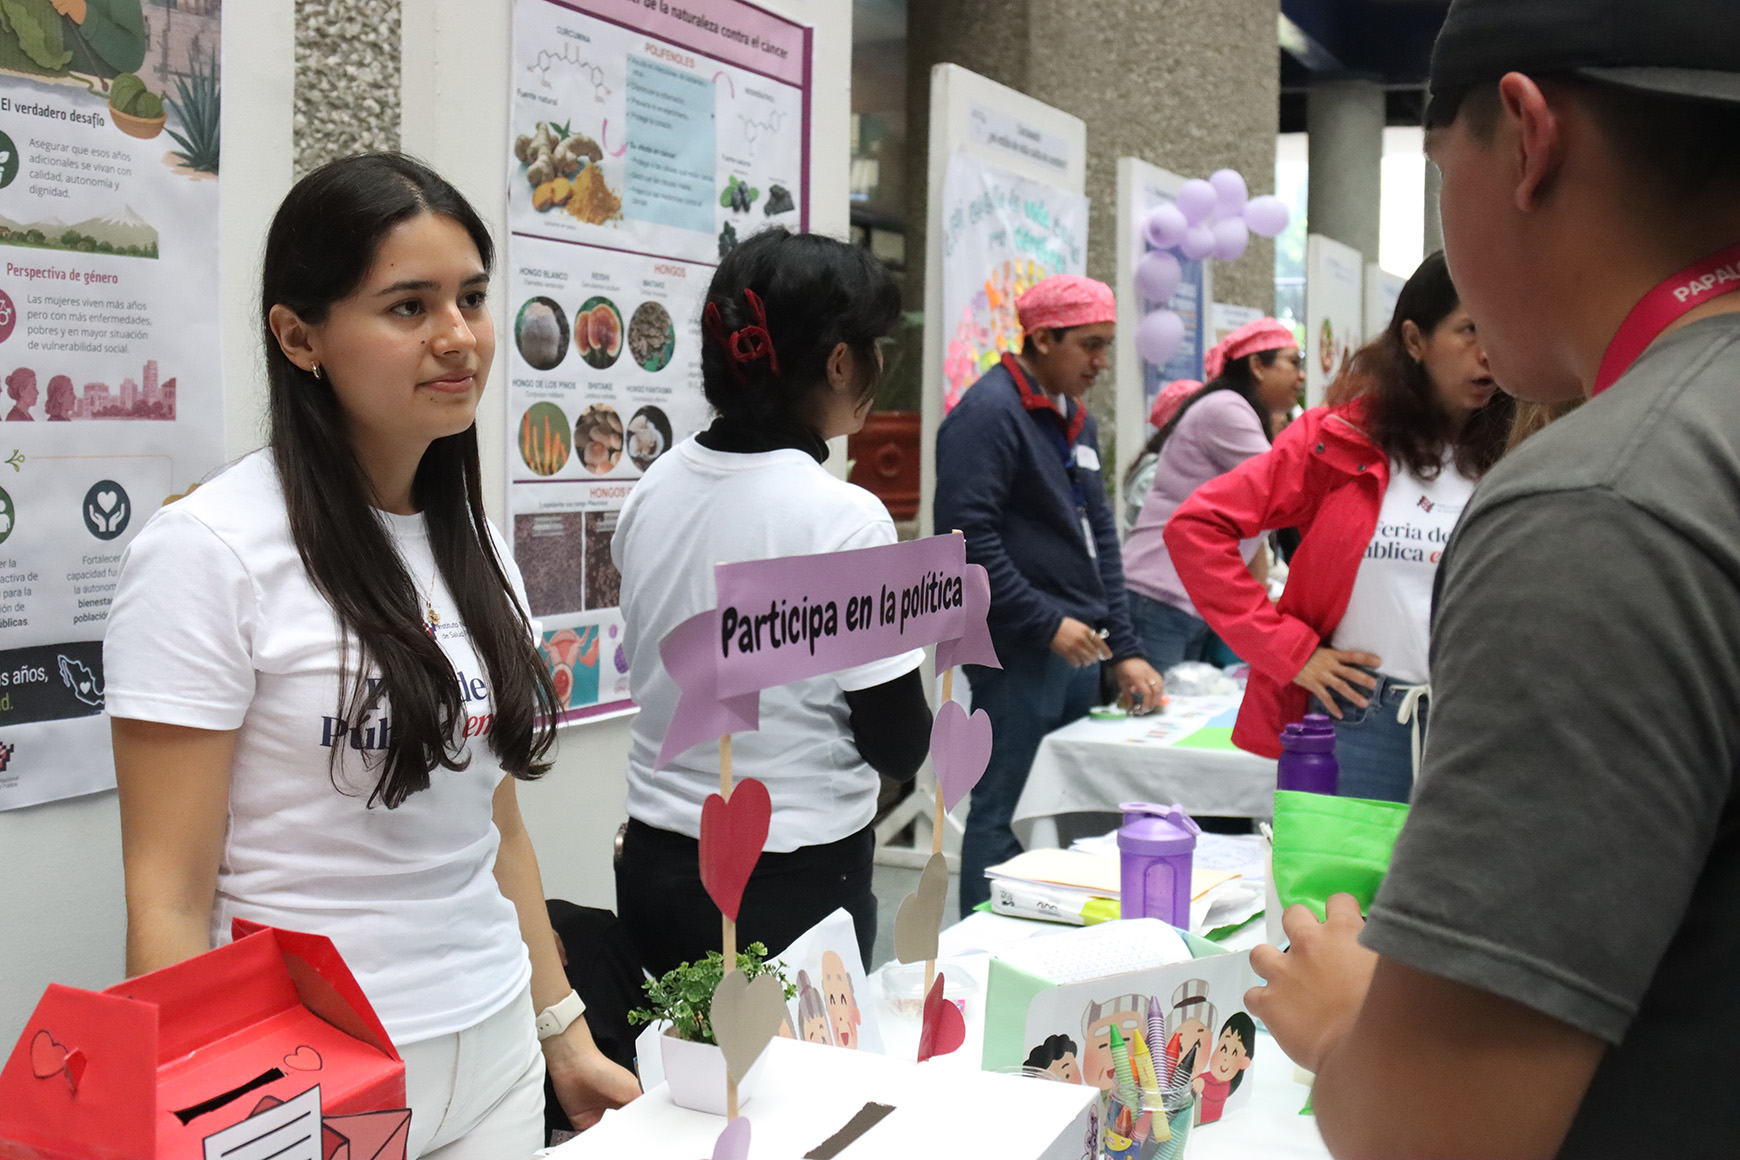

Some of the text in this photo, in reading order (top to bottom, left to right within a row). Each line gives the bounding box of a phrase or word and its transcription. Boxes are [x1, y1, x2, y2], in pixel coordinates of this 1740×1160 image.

[671, 6, 718, 34] naturaleza
[721, 26, 749, 46] contra
[645, 42, 695, 68] POLIFENOLES
[1, 98, 105, 128] El verdadero desafío
[29, 138, 131, 162] Asegurar que esos años
[29, 154, 132, 176] adicionales se vivan con
[29, 169, 63, 183] calidad,
[65, 176, 113, 189] autonomía
[29, 184, 70, 198] dignidad.
[6, 262, 118, 285] Perspectiva de género
[27, 294, 147, 311] Las mujeres viven más años
[27, 312, 48, 322] pero
[50, 313, 67, 321] con
[69, 312, 87, 322] más
[27, 325, 59, 337] pobres
[68, 328, 79, 337] en
[81, 330, 107, 340] mayor
[109, 329, 148, 340] situación
[28, 341, 129, 354] de vulnerabilidad social.
[589, 487, 625, 499] HONGOS
[82, 554, 120, 565] Fortalecer
[27, 571, 39, 582] de
[66, 569, 106, 581] capacidad
[3, 587, 32, 600] para la
[73, 585, 81, 595] la
[14, 602, 25, 612] de
[721, 570, 963, 659] Participa en la política
[12, 664, 49, 684] años,
[462, 713, 493, 738] en
